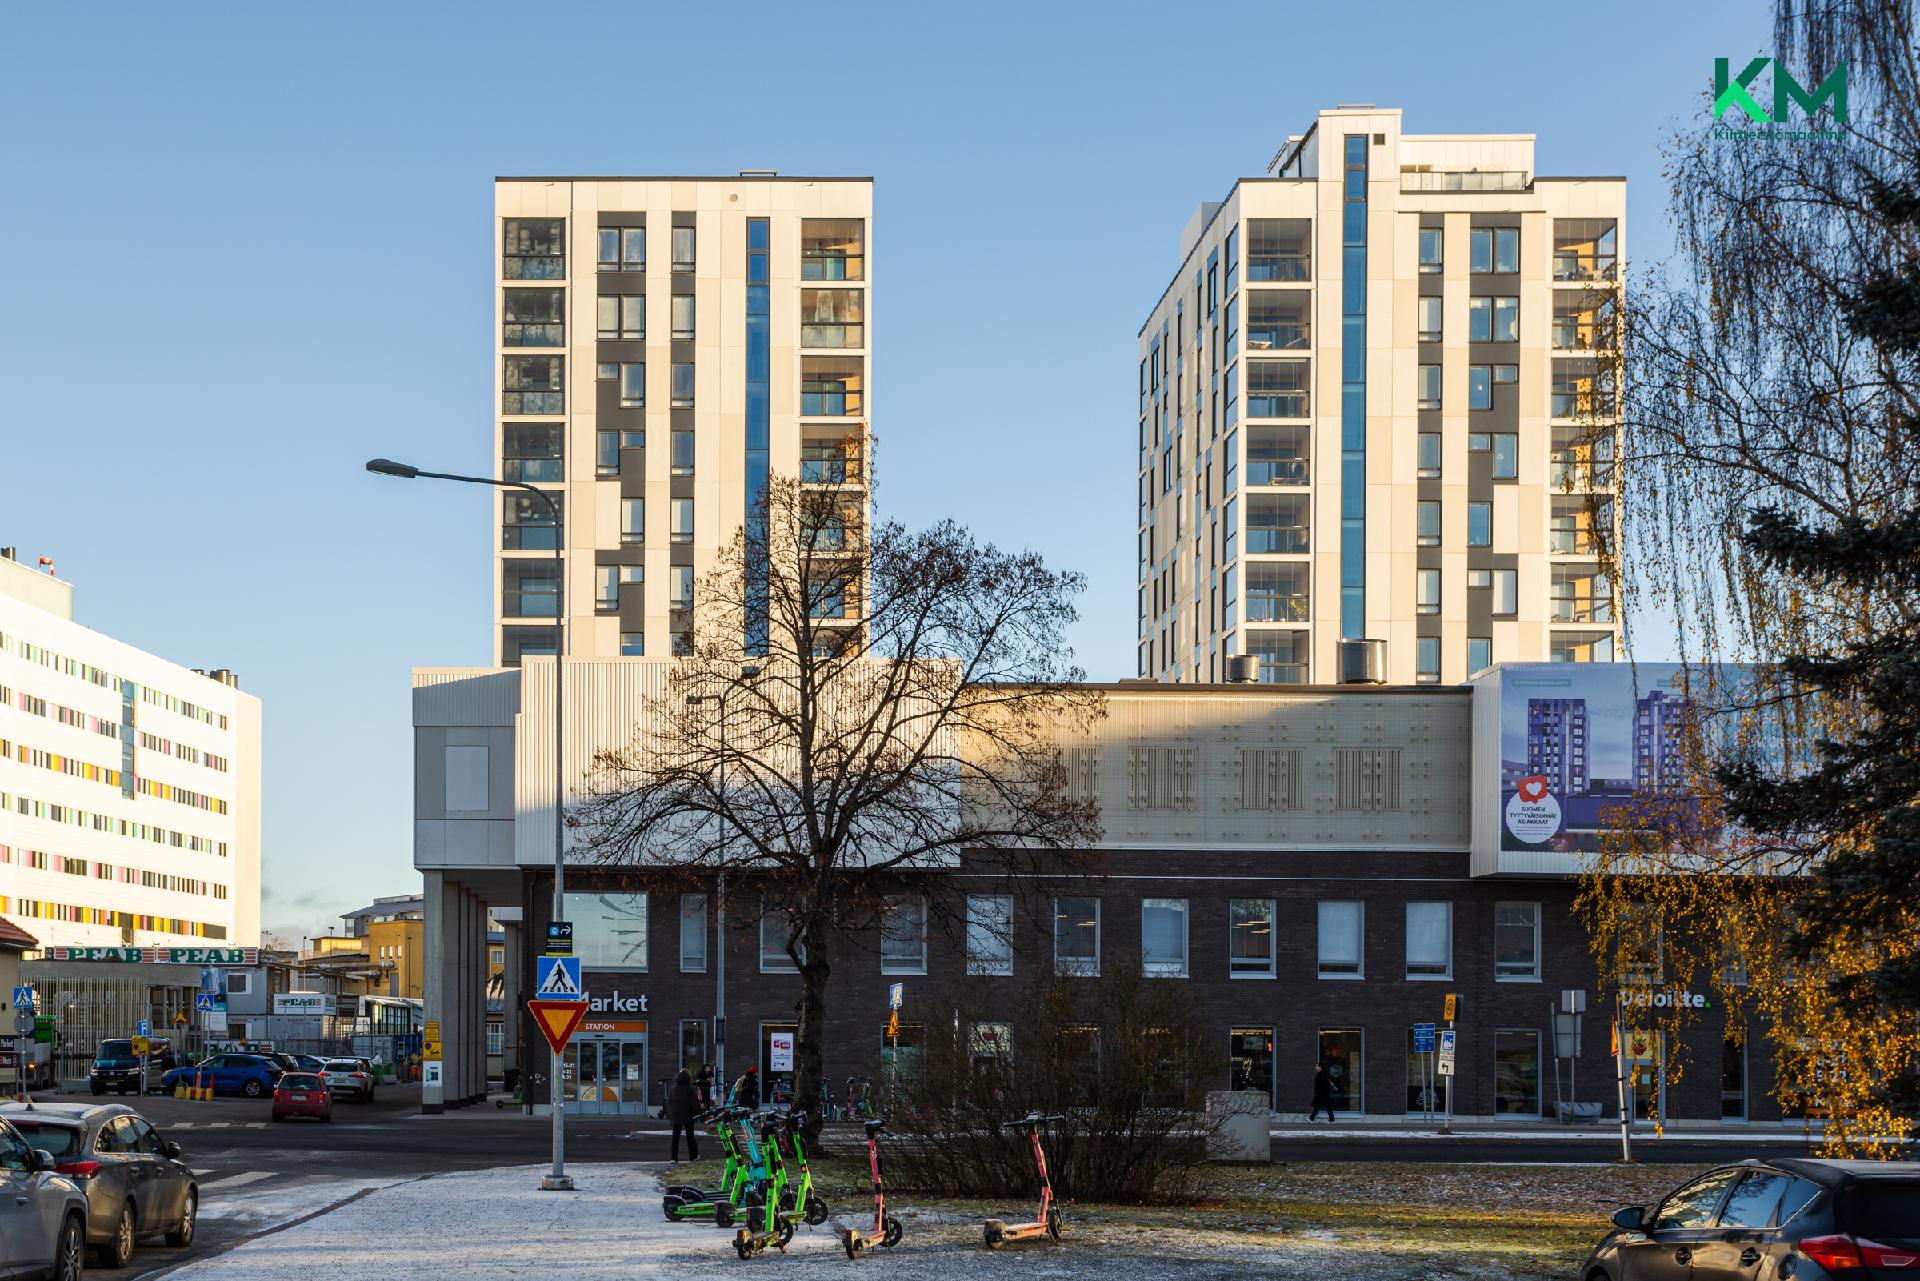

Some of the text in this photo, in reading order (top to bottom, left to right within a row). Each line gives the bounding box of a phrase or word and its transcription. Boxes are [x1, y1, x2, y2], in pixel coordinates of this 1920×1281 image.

[67, 947, 143, 963] PEAB
[169, 948, 245, 964] PEAB
[282, 998, 316, 1006] PEAB
